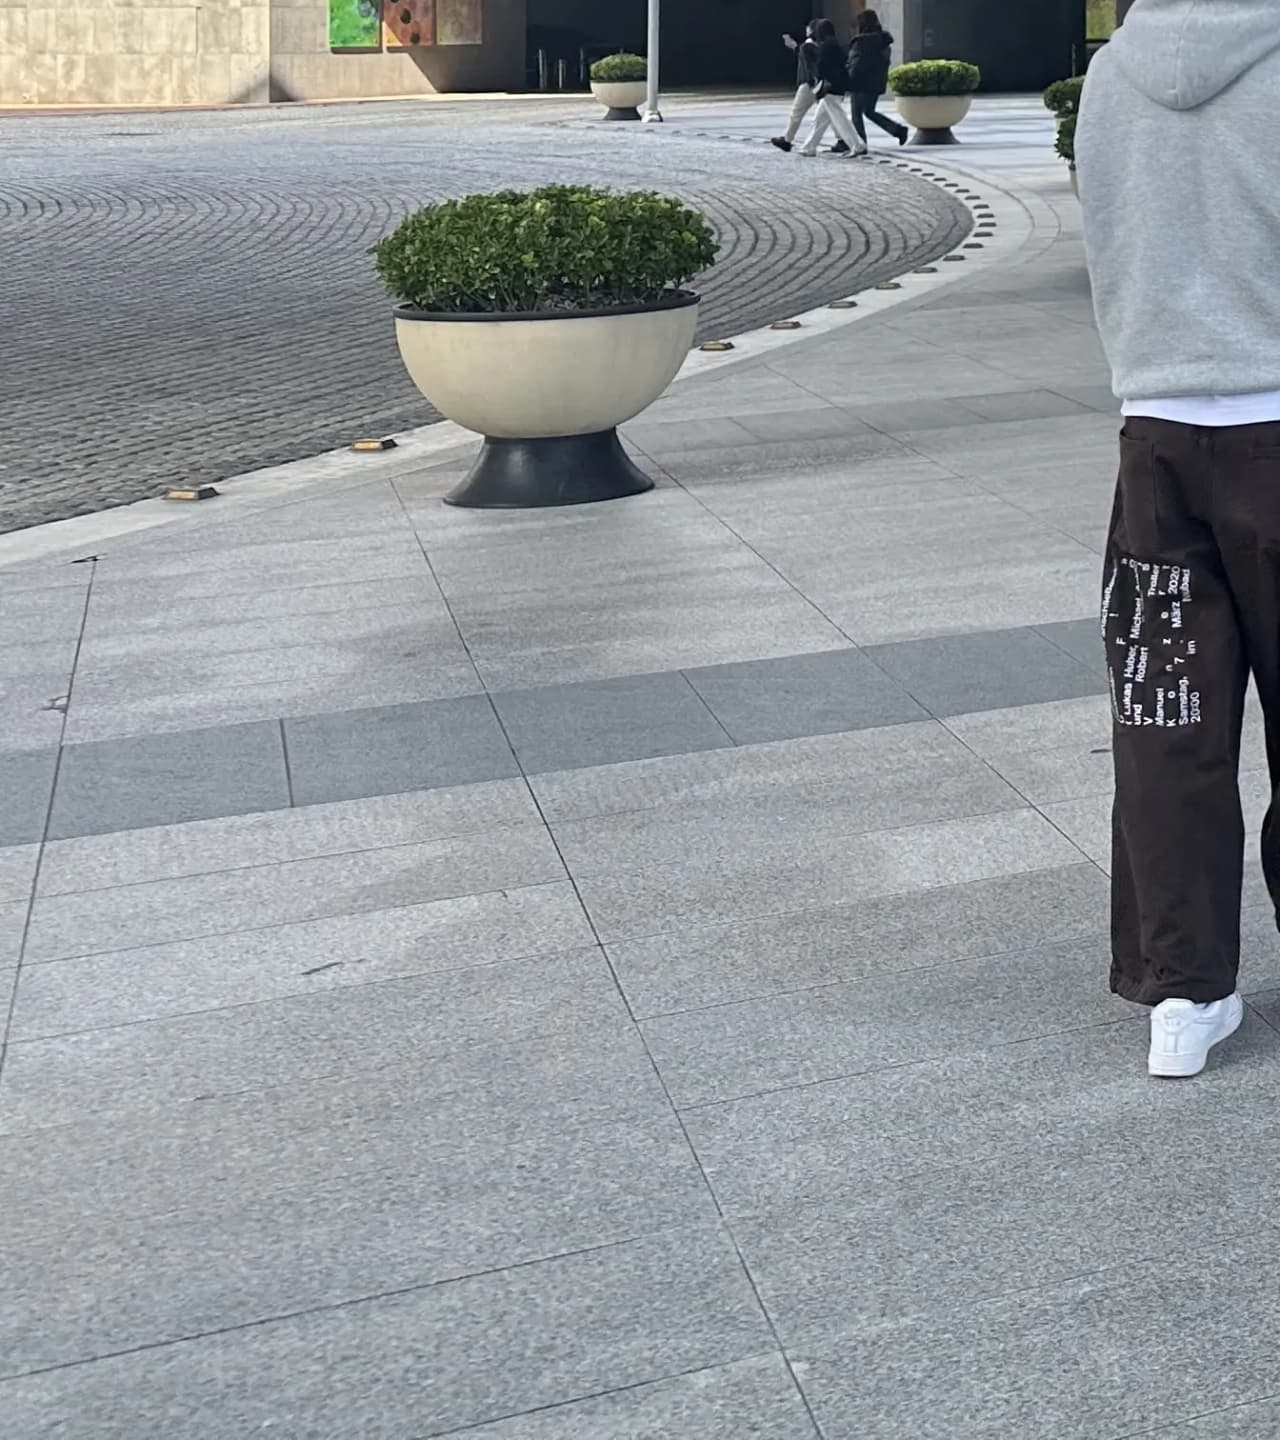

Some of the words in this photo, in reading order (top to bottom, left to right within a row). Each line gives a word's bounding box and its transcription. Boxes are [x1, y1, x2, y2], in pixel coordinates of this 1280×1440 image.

[1168, 565, 1180, 595] 2020
[1135, 646, 1149, 682] Robert
[1133, 704, 1143, 725] und
[1155, 687, 1164, 727] Manuel
